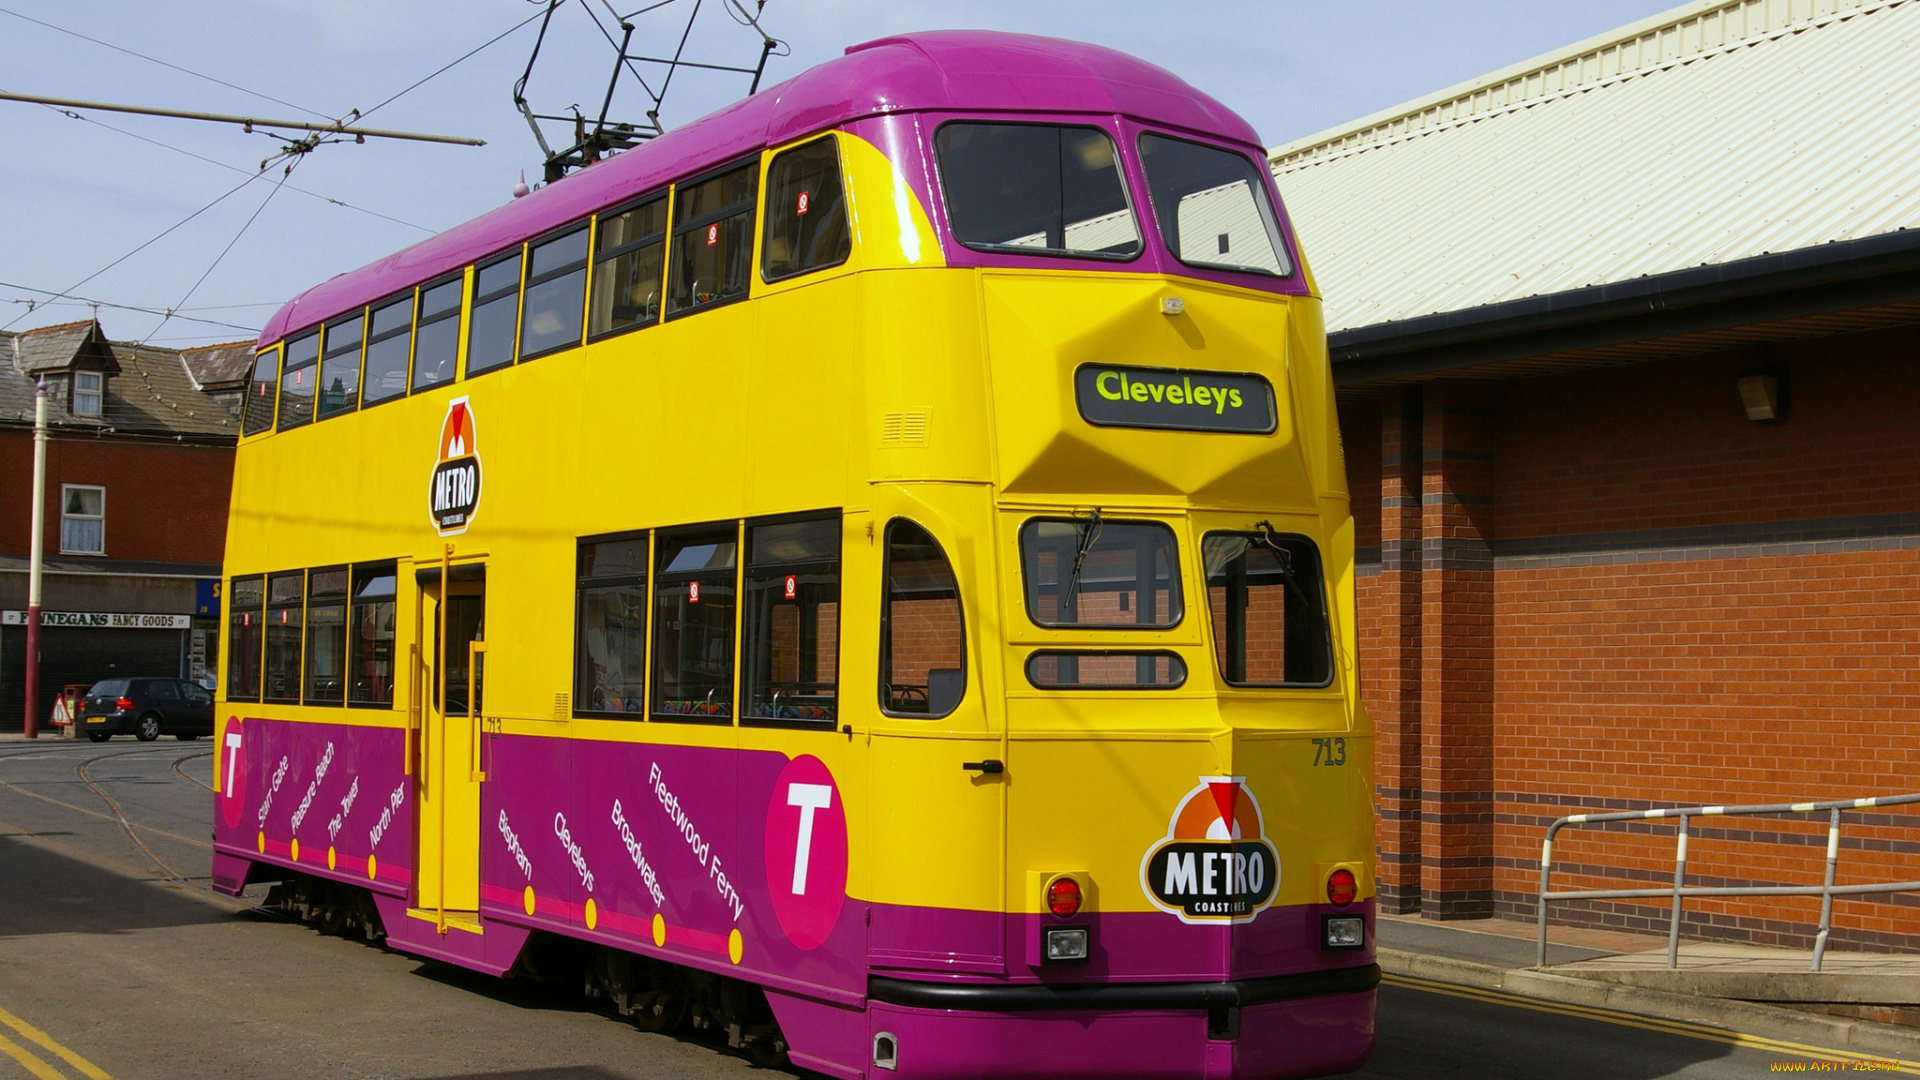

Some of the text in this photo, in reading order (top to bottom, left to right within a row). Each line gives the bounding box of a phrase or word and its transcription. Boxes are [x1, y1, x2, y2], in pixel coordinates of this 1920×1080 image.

[1095, 371, 1243, 415] Cleveleys
[434, 464, 475, 512] METRO
[112, 614, 140, 626] FANCY
[142, 615, 174, 627] GOODS
[226, 733, 242, 798] T
[1311, 737, 1347, 767] 713
[258, 755, 289, 829] Starr Gate
[291, 741, 334, 836] Pleasure Beach
[327, 775, 359, 842] The Tower
[369, 781, 405, 850] North Pier
[499, 808, 533, 881] Bispham
[554, 812, 595, 892] Cleveleys
[611, 798, 666, 908] Broadwater
[649, 761, 744, 922] Fleetwood Ferry
[787, 782, 832, 896] T
[1164, 851, 1264, 896] METRO
